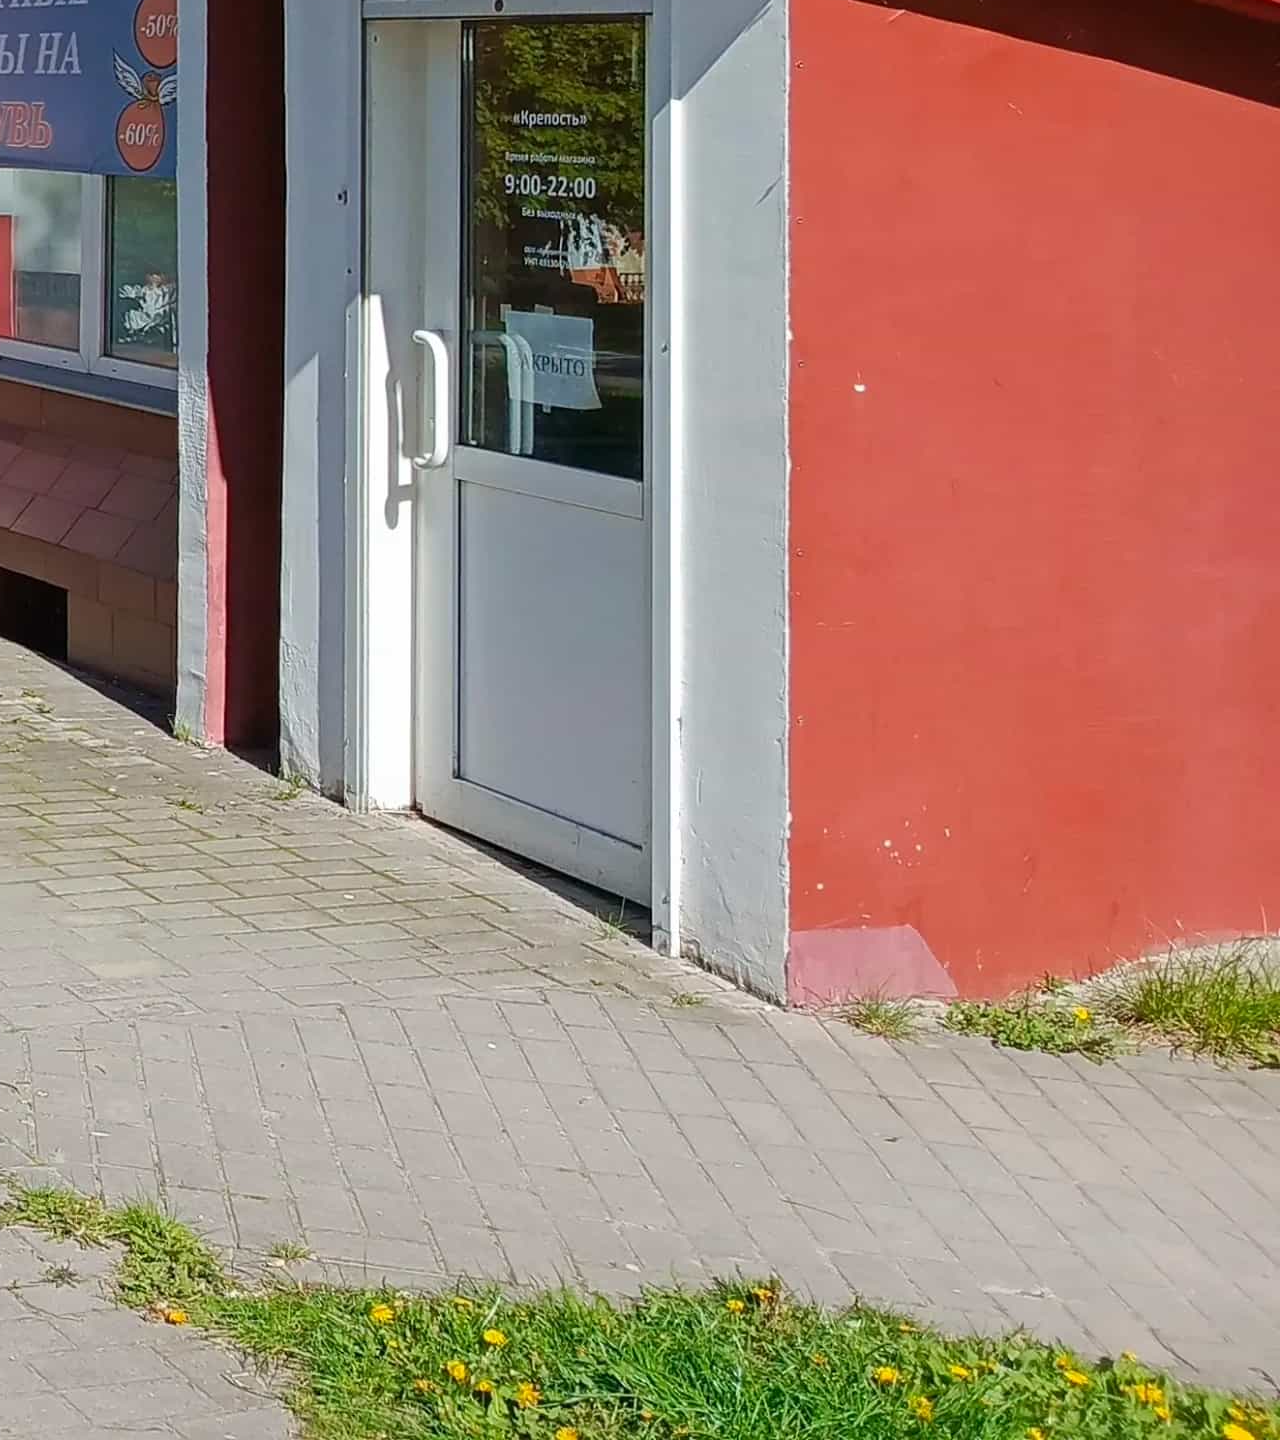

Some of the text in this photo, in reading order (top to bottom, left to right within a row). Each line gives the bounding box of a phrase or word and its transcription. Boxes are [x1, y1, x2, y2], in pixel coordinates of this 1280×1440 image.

[140, 14, 177, 39] -50%
[34, 31, 83, 76] НА
[513, 110, 587, 129] «Крепость»
[120, 122, 161, 146] -60%
[505, 173, 596, 199] 9:00-22:00
